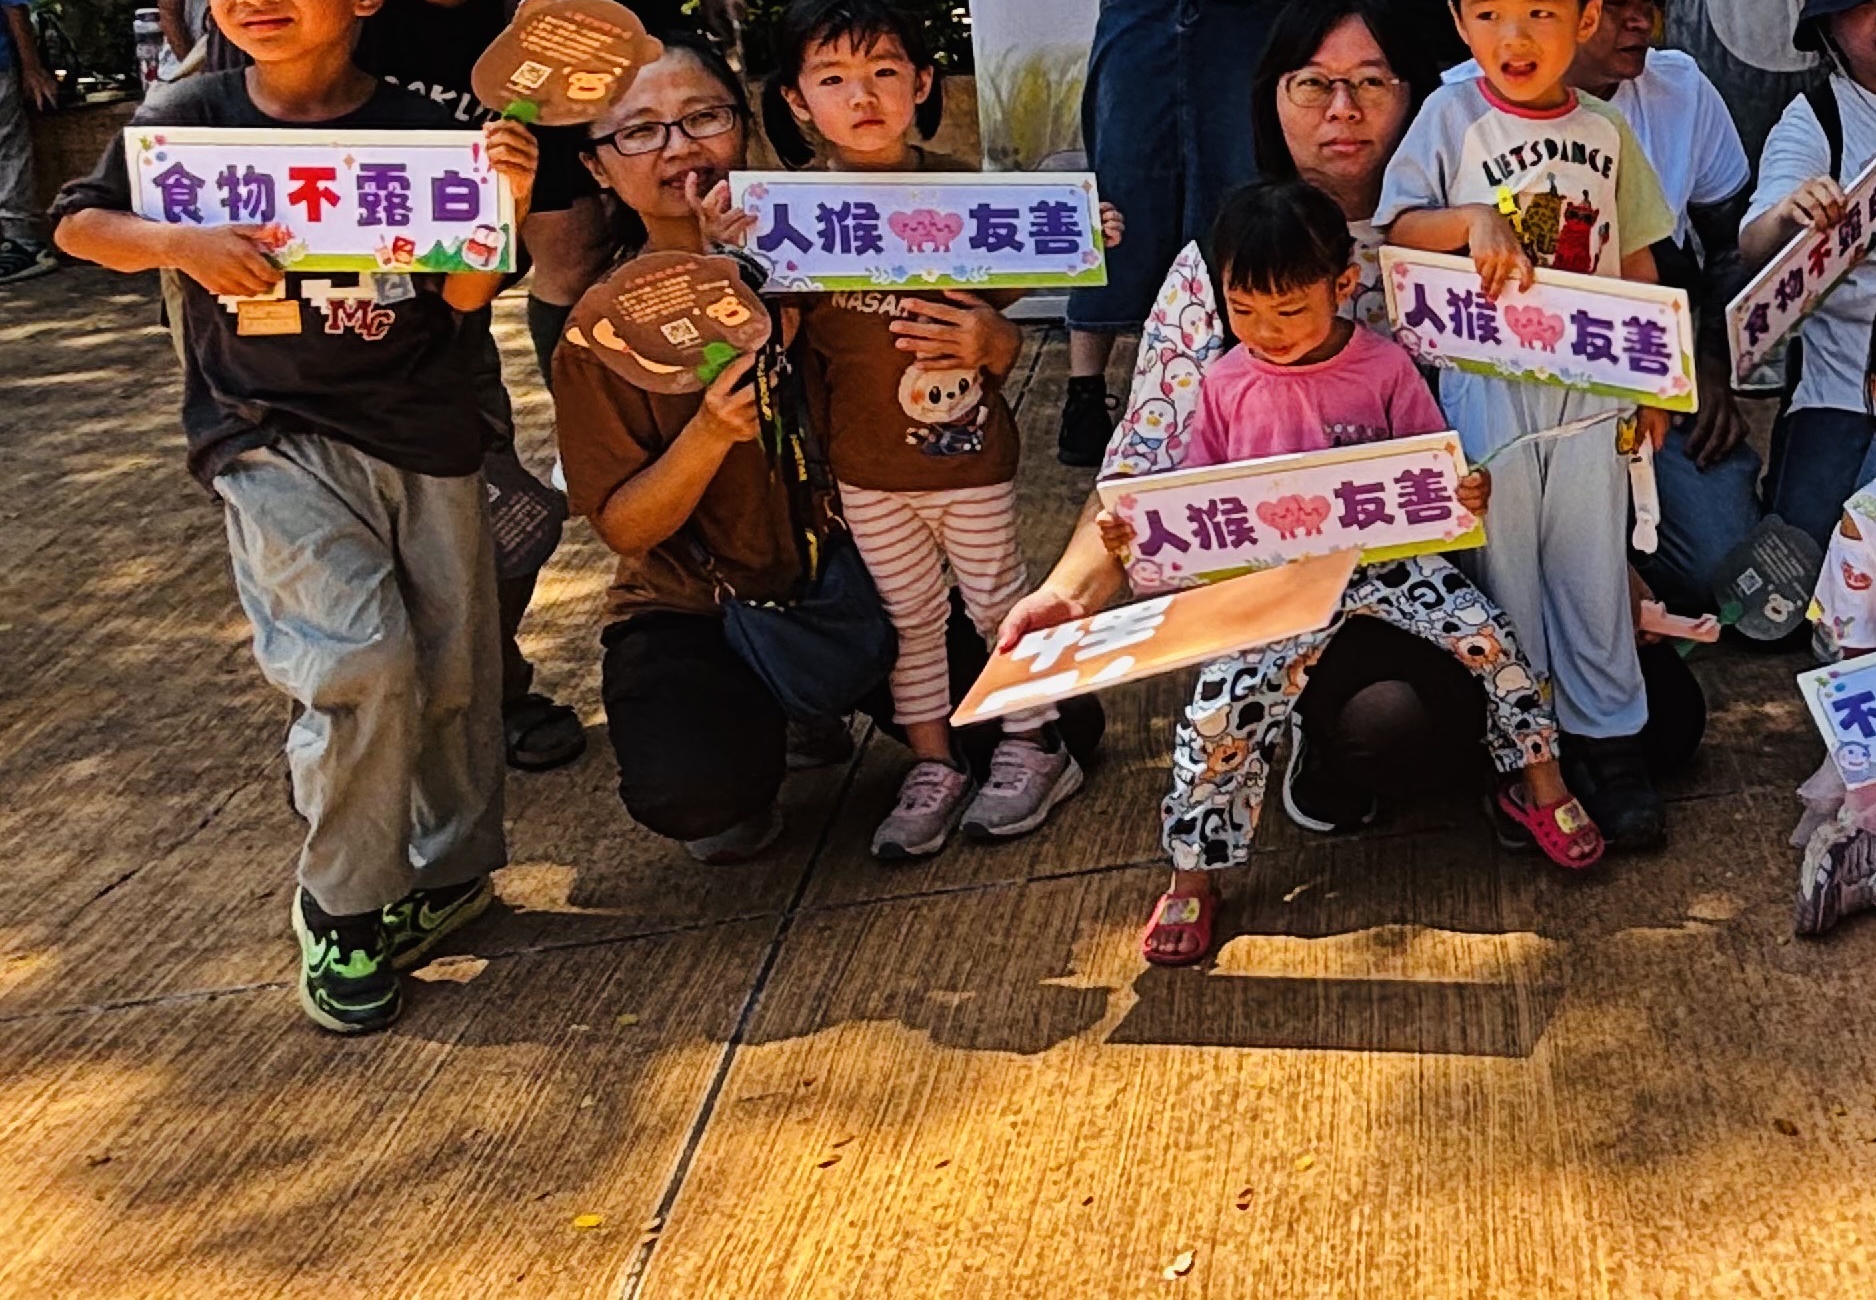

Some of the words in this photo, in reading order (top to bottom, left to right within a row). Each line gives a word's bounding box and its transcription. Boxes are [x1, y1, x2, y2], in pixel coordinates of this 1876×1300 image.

[153, 161, 481, 227] 食物不露白
[756, 200, 884, 256] 人猴
[968, 200, 1083, 256] 友善
[1405, 282, 1503, 347] 人猴
[1570, 308, 1673, 377] 友善
[1138, 496, 1259, 558] 人猴
[1333, 467, 1454, 531] 友善
